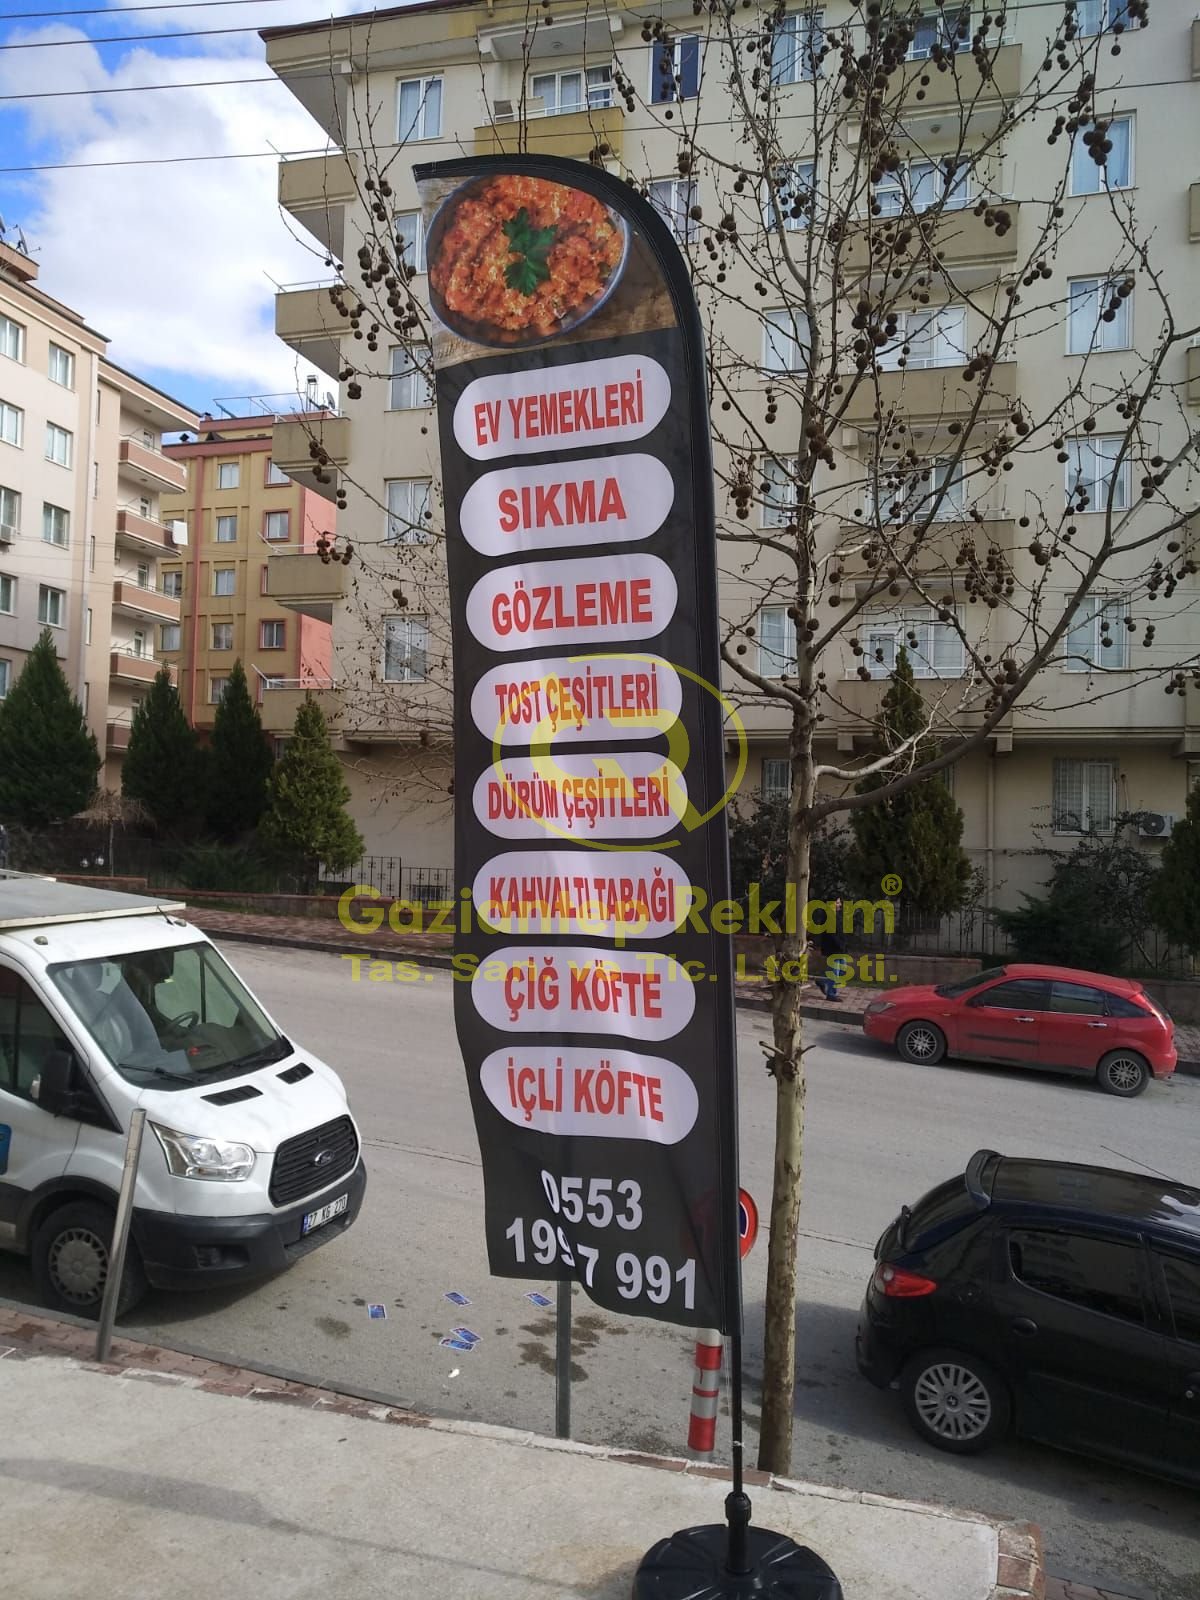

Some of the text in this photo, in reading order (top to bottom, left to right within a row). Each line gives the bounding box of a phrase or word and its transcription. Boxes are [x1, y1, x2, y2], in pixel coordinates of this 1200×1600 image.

[474, 369, 644, 446] EV YEMEKLERİ
[498, 477, 627, 532] SIKMA
[492, 580, 653, 636] GÖZLEME
[495, 662, 658, 732] TOST ÇEŞİTLERİ
[488, 766, 670, 829] DÜRÜM ÇEŞİTLERİ
[489, 867, 675, 922] KAHVALTI TABAĞI
[504, 956, 662, 1022] ÇİĞ KÖFTE
[507, 1056, 664, 1123] İÇLİ KÖFTE
[308, 1212, 318, 1228] 27
[541, 1169, 643, 1230] 0553
[506, 1217, 696, 1310] 1997 991
